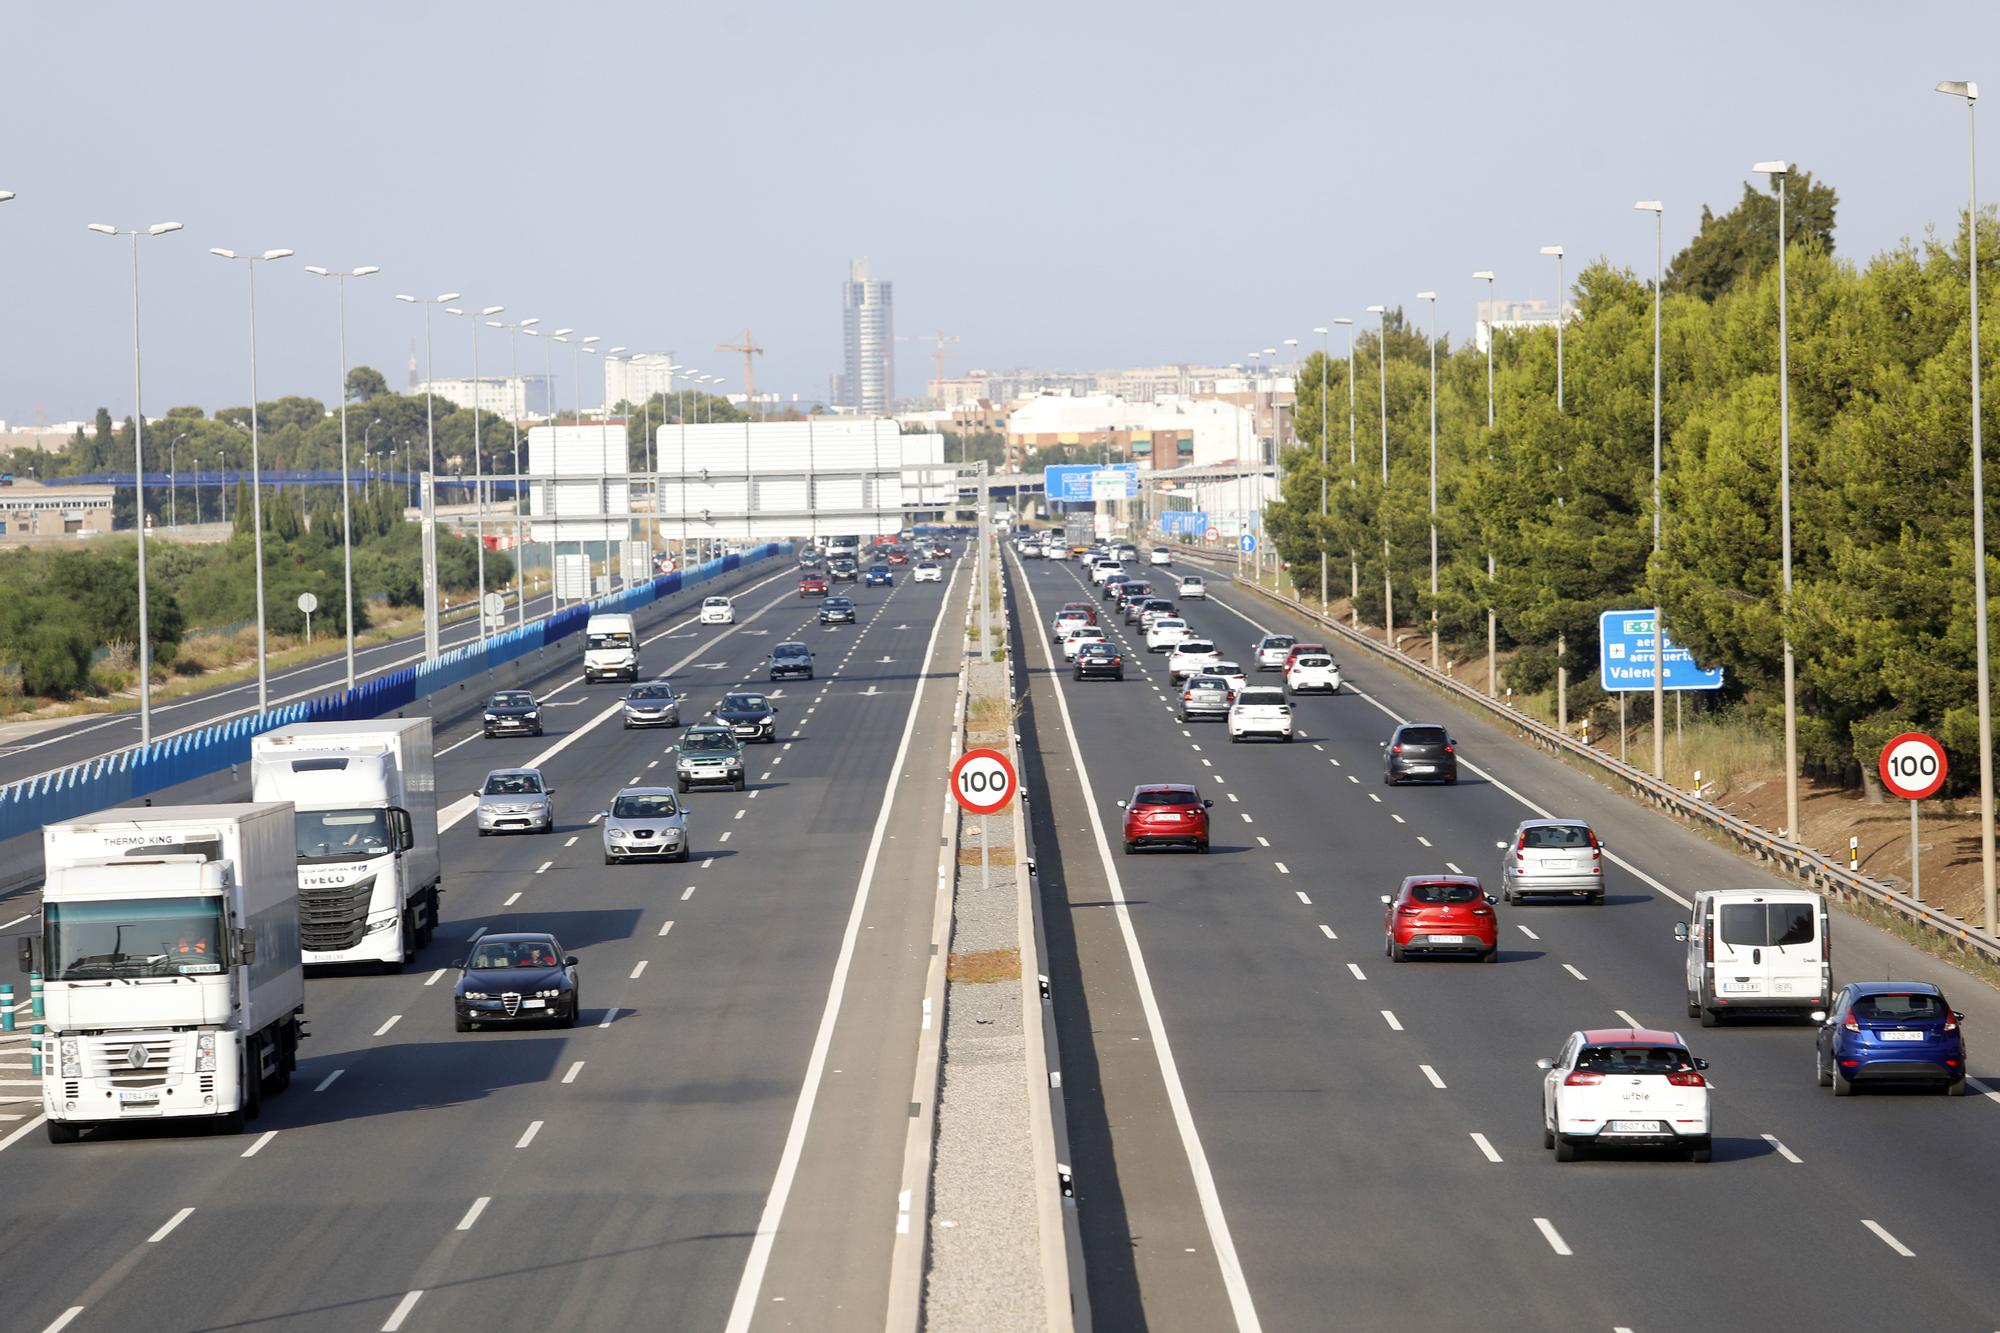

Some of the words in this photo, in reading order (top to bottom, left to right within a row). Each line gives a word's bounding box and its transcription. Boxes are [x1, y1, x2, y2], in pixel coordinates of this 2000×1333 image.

[1629, 651, 1694, 663] aerouerto
[1610, 666, 1671, 679] Valenca
[1891, 755, 1937, 777] 100
[961, 770, 1006, 792] 100
[103, 837, 145, 846] THERMO
[149, 835, 173, 844] KING
[304, 875, 345, 885] IVECO
